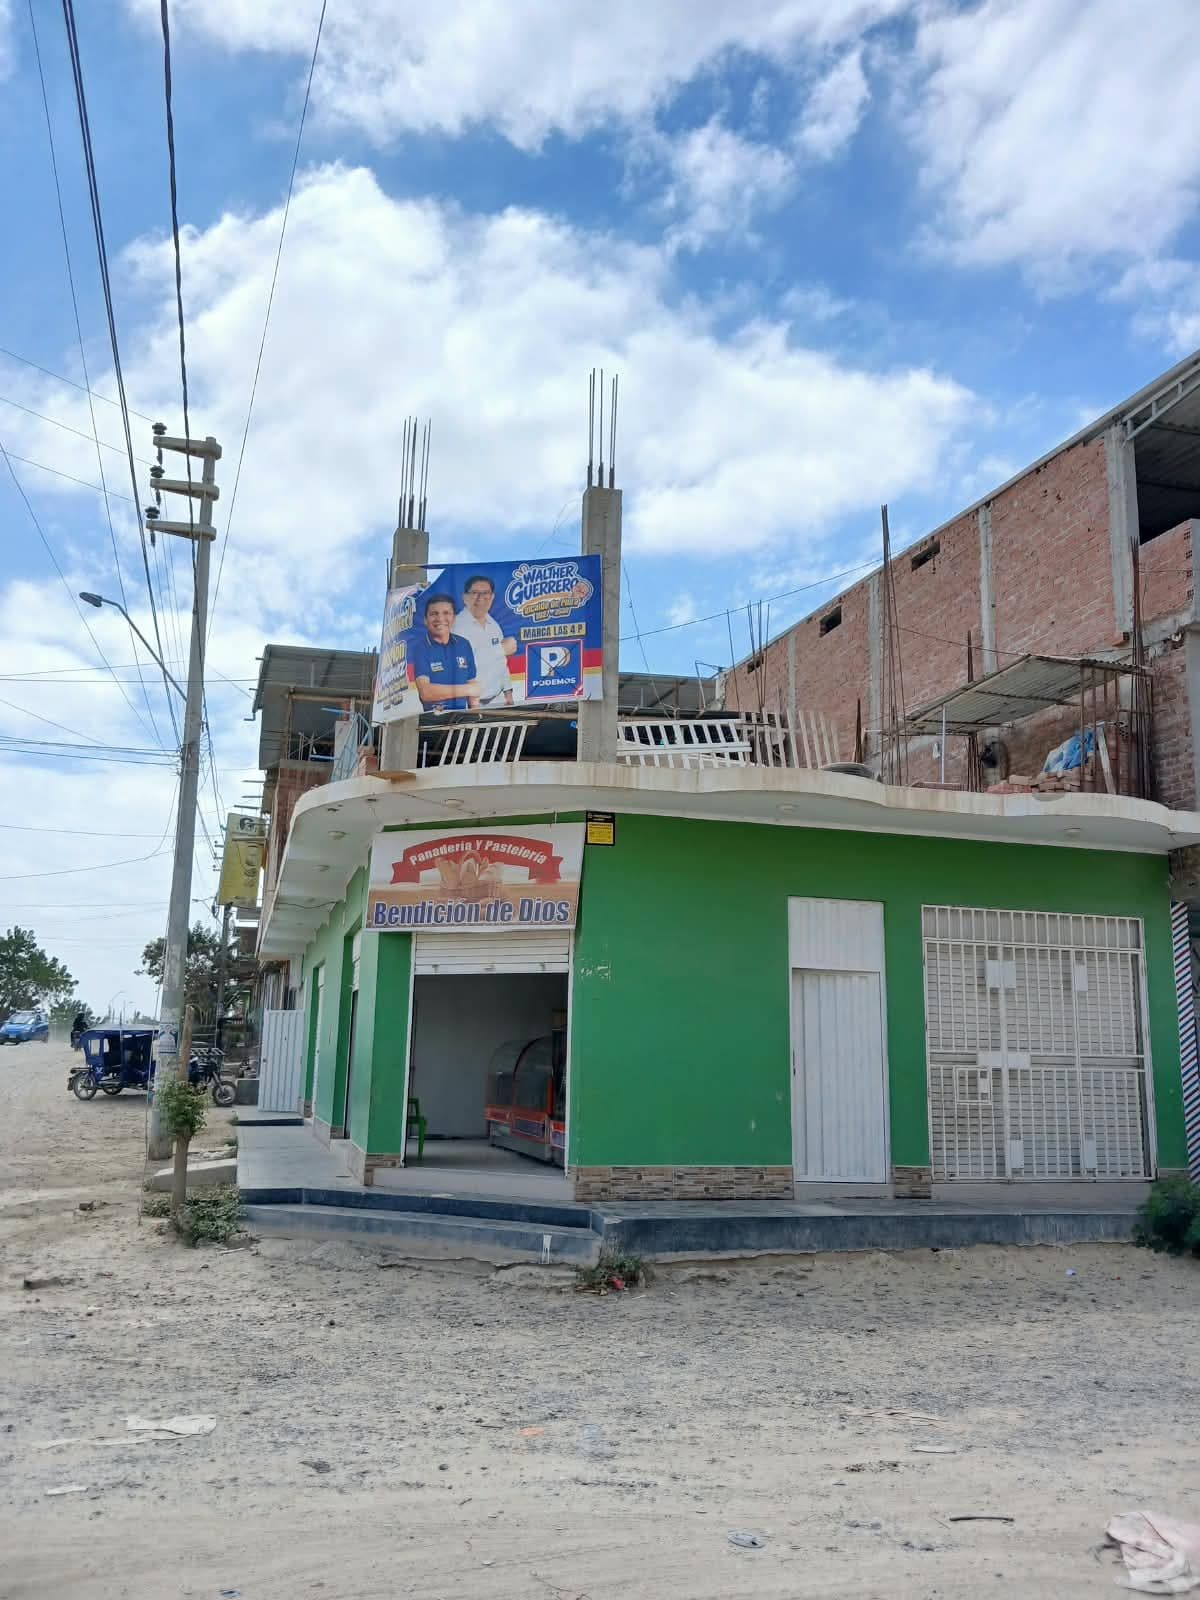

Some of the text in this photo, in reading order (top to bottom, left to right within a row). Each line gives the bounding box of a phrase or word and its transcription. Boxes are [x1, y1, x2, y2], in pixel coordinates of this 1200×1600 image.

[523, 565, 574, 584] WALTHER
[508, 577, 579, 605] GUERRERO
[523, 623, 584, 639] MARCA LAS 4 P
[532, 677, 576, 687] PODEMOS
[475, 840, 483, 851] Y
[374, 897, 570, 925] Bendición de Dios
